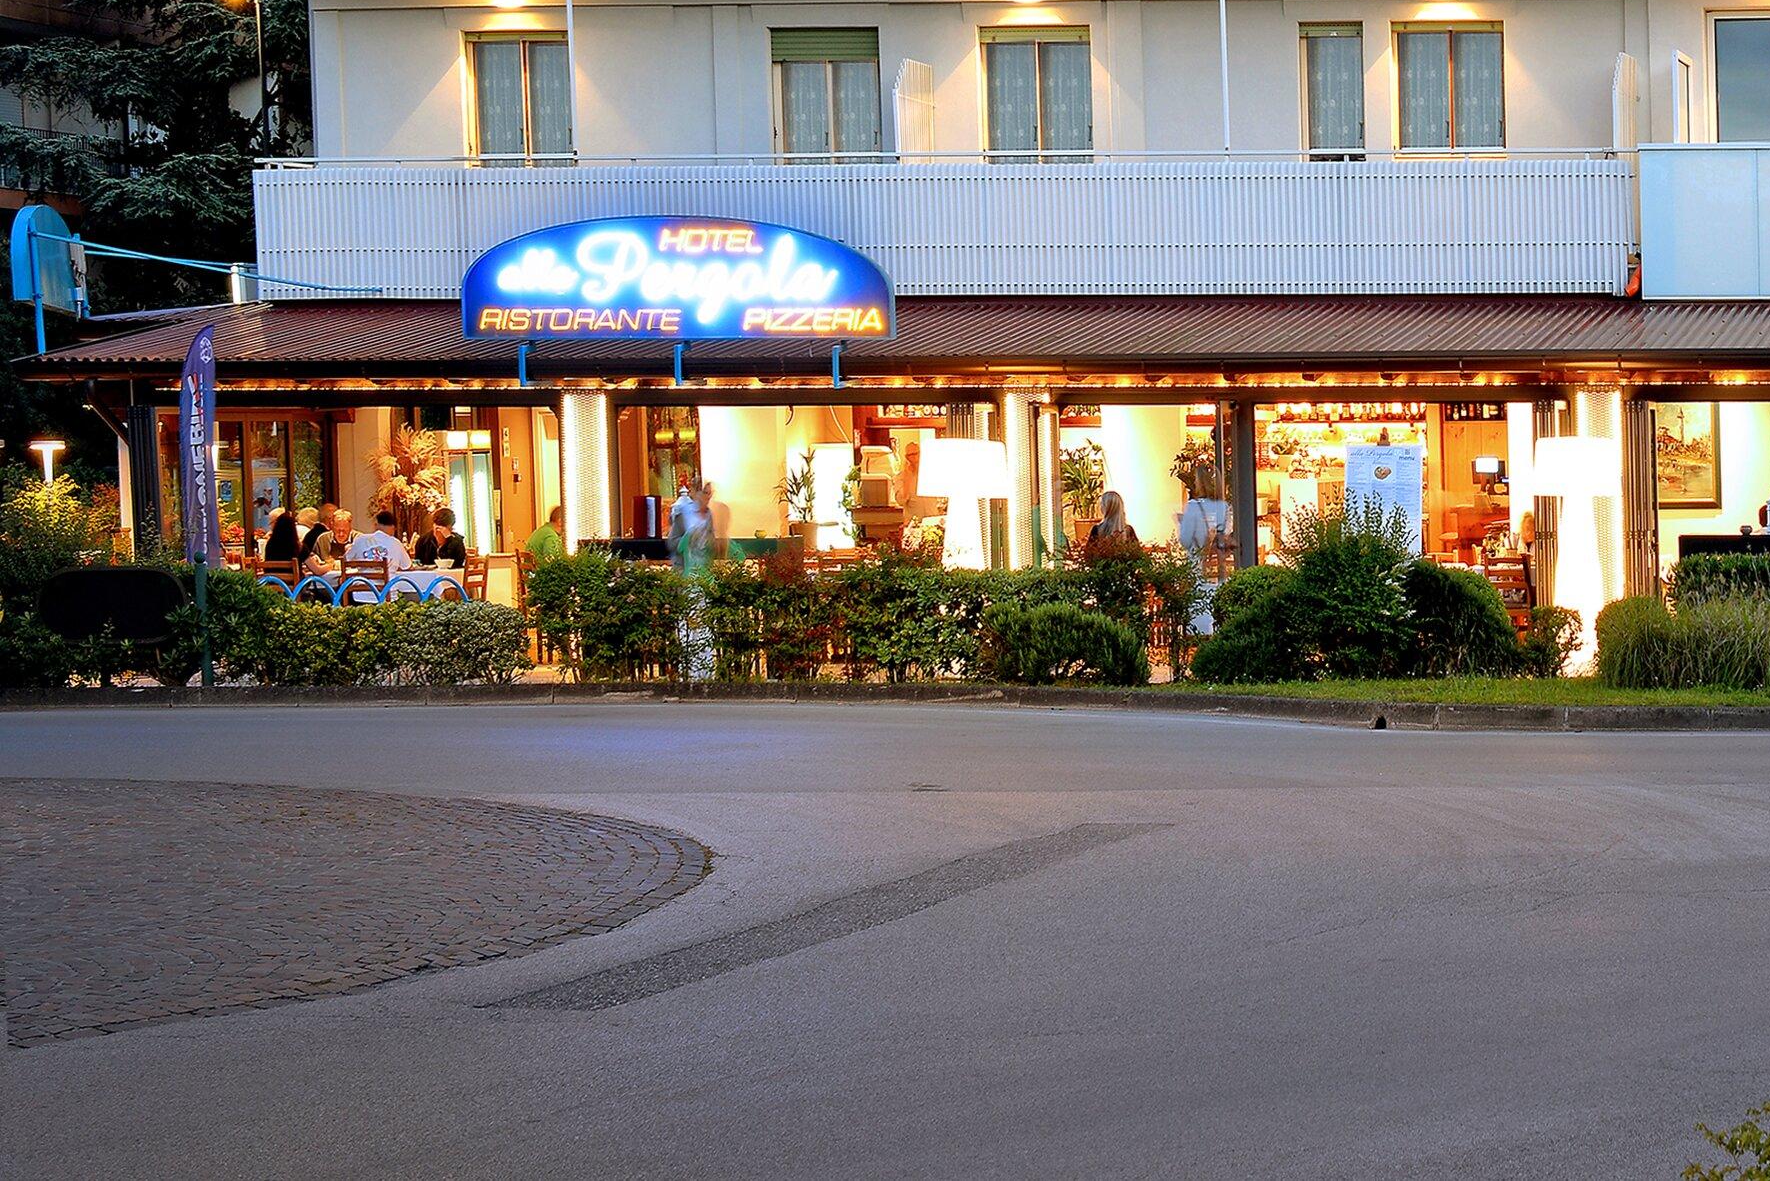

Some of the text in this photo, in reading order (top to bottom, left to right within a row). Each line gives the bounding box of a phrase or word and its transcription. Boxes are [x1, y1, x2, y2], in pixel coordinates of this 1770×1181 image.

[658, 228, 764, 254] HOTEL
[577, 229, 840, 325] Pergola
[479, 307, 883, 332] RISTORANTE PIZZERIA
